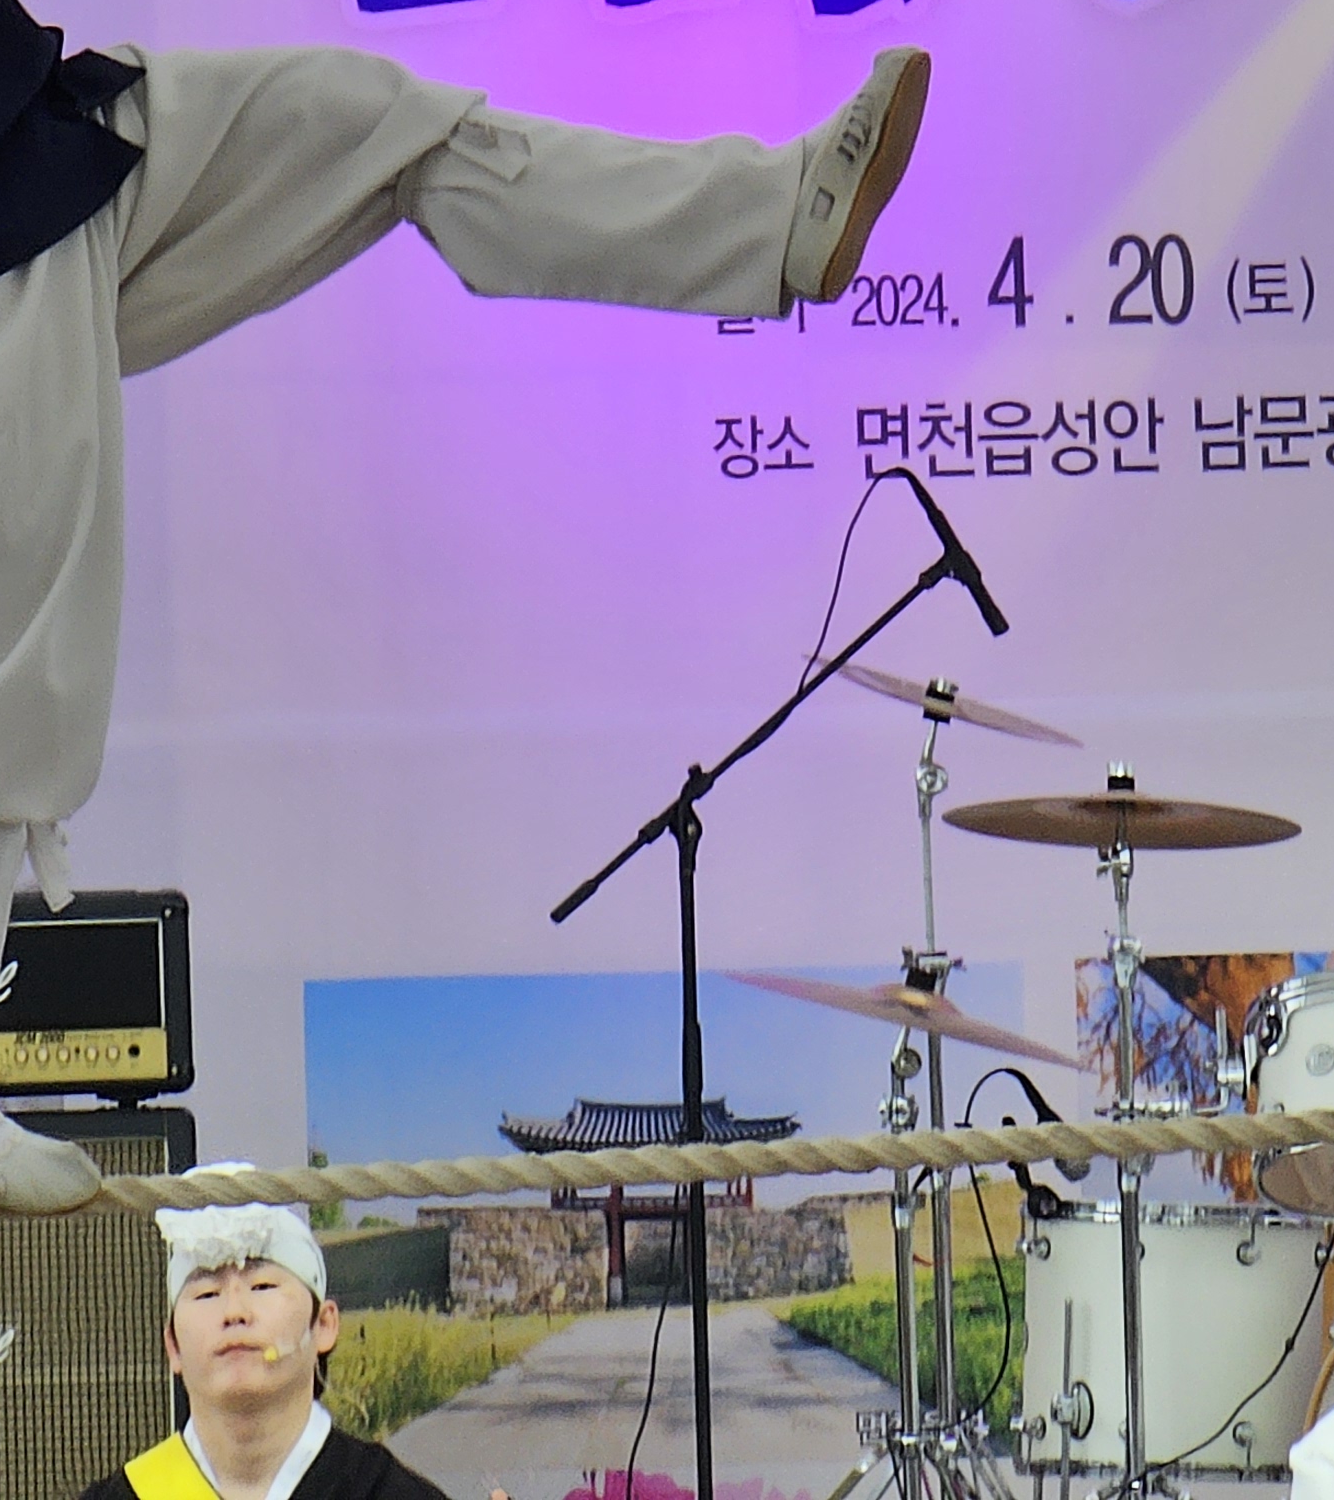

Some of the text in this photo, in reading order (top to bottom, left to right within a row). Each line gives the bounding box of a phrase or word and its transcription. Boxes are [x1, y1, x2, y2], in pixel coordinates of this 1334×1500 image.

[851, 274, 960, 327] 2024.
[1226, 257, 1316, 321] (토)
[713, 415, 814, 478] 장소
[857, 397, 1163, 479] 면천읍성안
